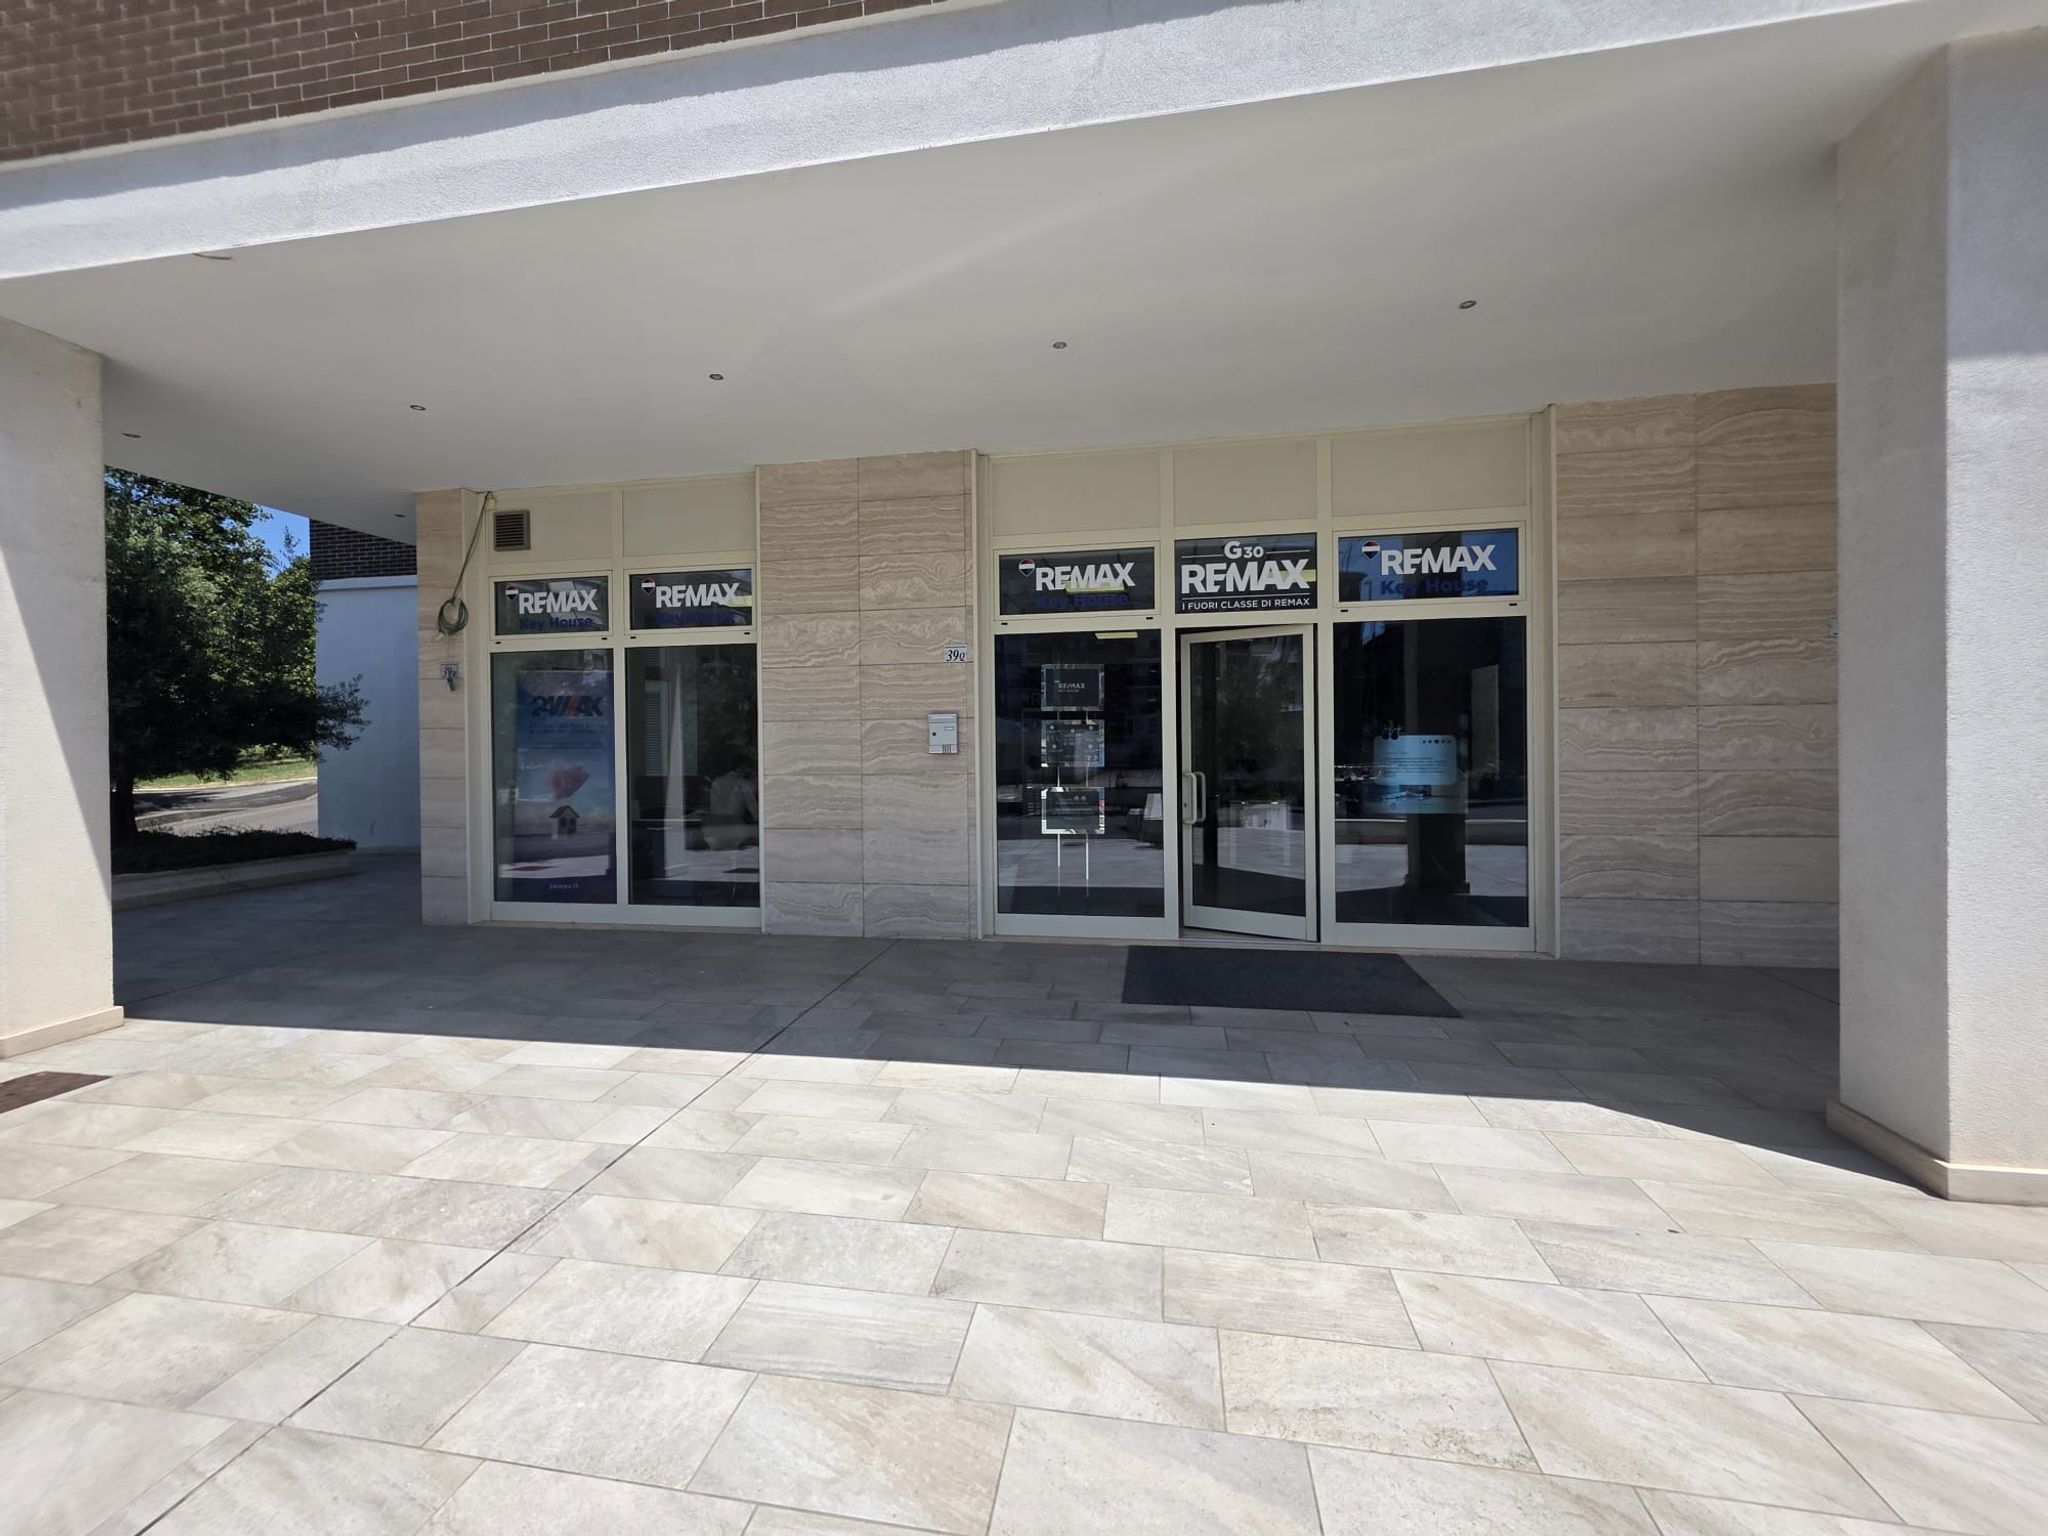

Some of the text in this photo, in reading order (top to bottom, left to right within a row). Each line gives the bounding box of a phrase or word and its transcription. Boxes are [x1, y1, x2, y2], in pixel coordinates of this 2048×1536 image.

[1224, 541, 1264, 559] G30
[1381, 545, 1497, 576] REMAX
[1035, 562, 1136, 591] REMAX
[1181, 559, 1310, 594] REMAX
[1424, 578, 1488, 593] House
[519, 589, 598, 614] REMAX
[655, 583, 740, 609] REMAX
[1182, 602, 1185, 610] I
[1188, 601, 1218, 610] FUORI
[1220, 600, 1258, 609] CLASSE
[1274, 598, 1310, 607] REMAX
